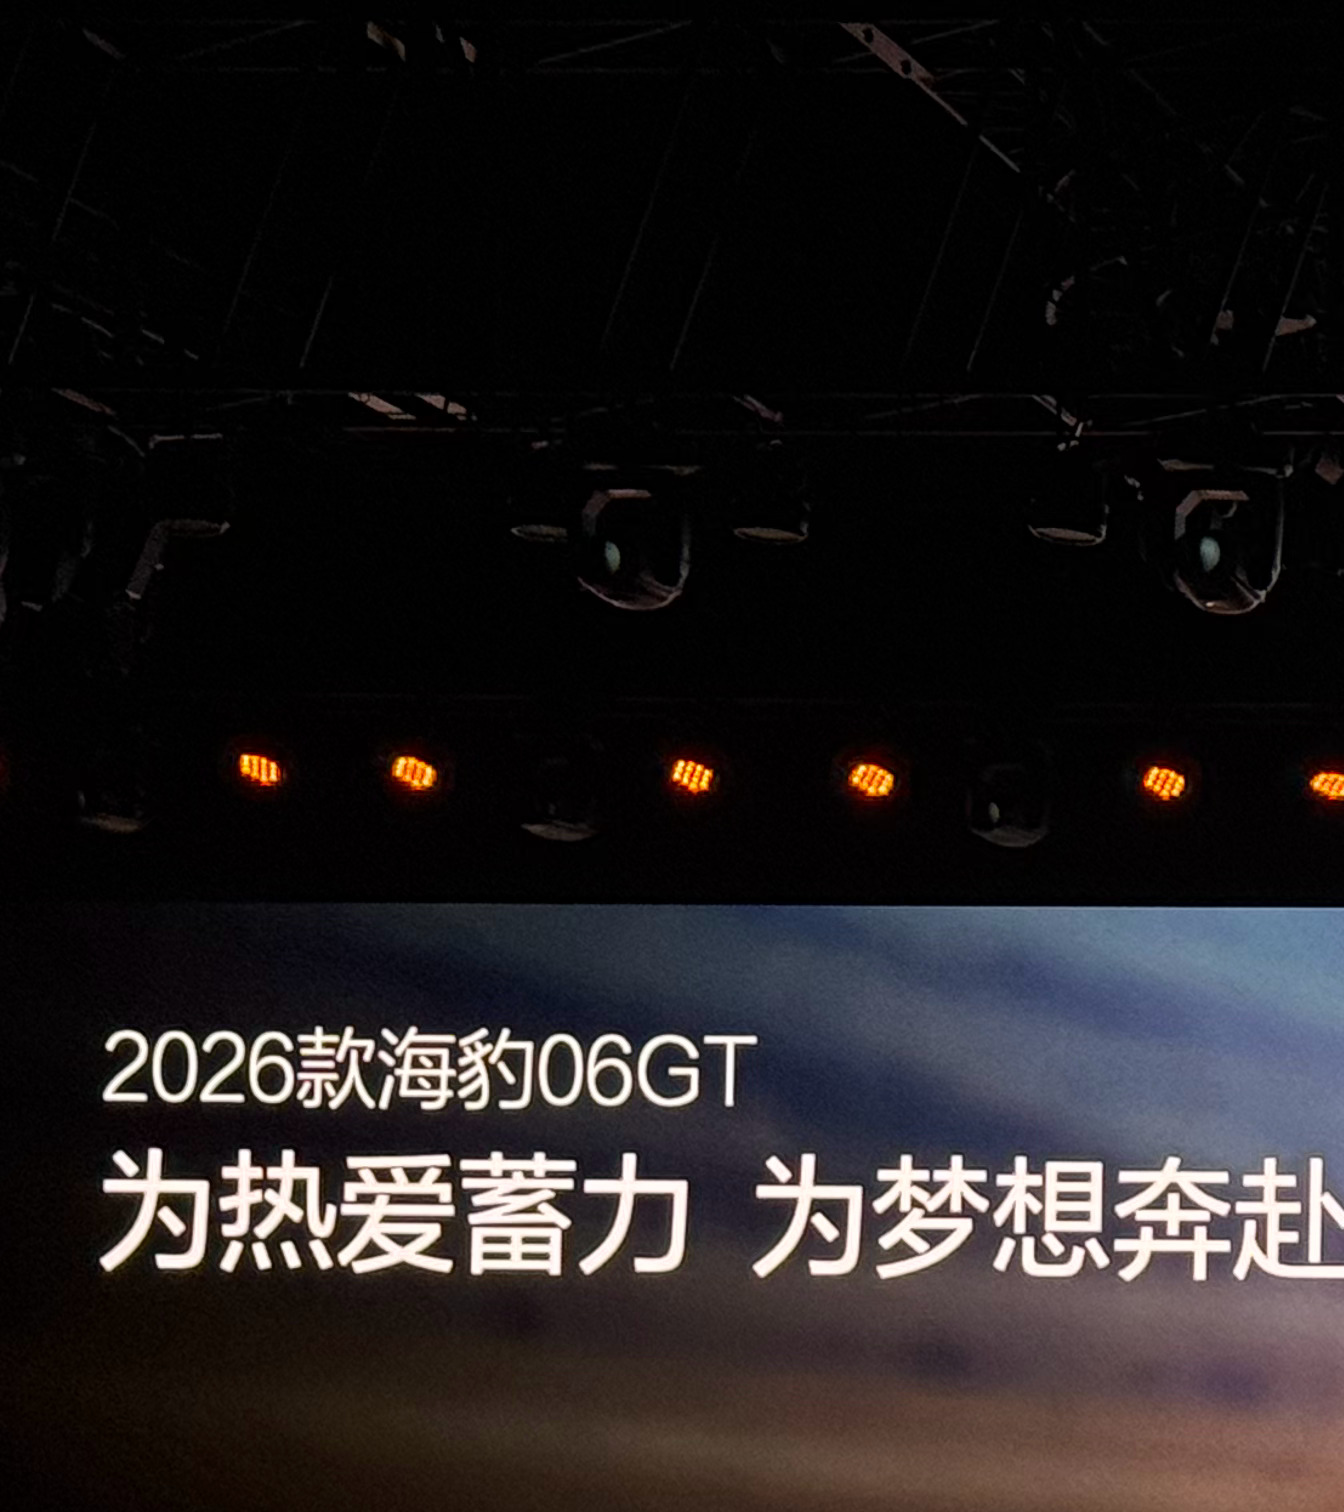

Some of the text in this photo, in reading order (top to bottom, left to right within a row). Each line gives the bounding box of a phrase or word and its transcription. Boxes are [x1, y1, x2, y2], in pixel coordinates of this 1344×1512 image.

[102, 1026, 758, 1111] 2026款海豹06GT
[100, 1147, 688, 1277] 为热爱蓄力
